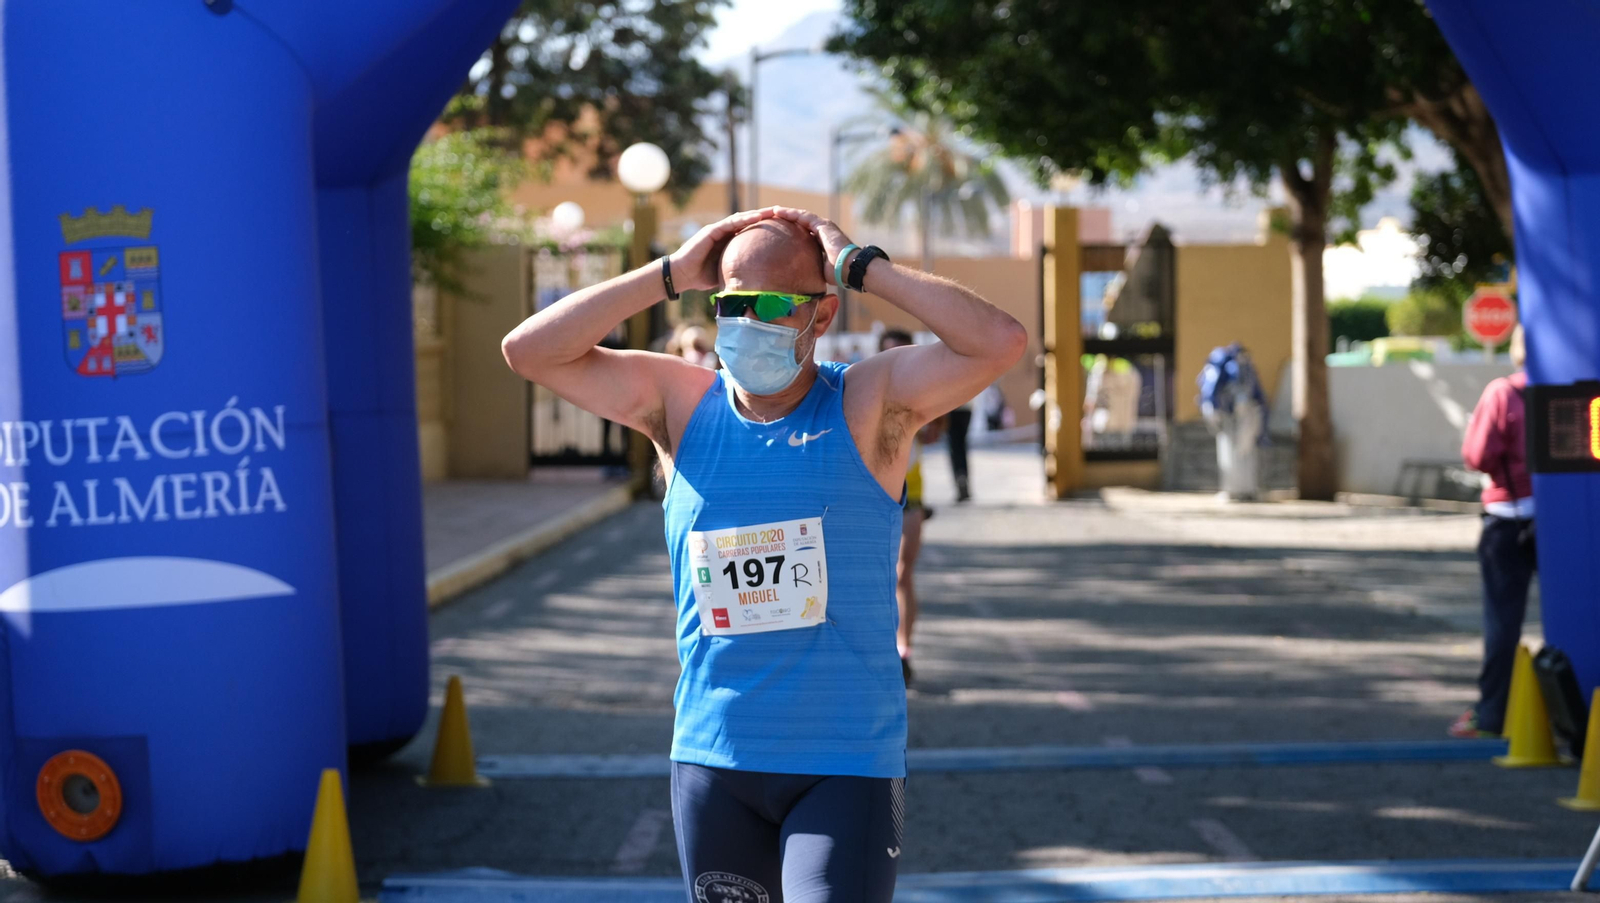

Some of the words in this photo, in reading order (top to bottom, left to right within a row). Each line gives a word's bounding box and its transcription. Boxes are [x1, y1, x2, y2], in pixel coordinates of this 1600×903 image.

[0, 396, 286, 466] IPUTACIÓN
[46, 456, 287, 527] ALMERÍA
[716, 533, 758, 549] CIRCUITO
[760, 528, 785, 545] 2020
[718, 547, 750, 559] CARRERAS
[751, 542, 786, 555] POPULARES
[723, 555, 785, 590] 197
[791, 563, 812, 588] R
[738, 588, 780, 606] MIGUEL
